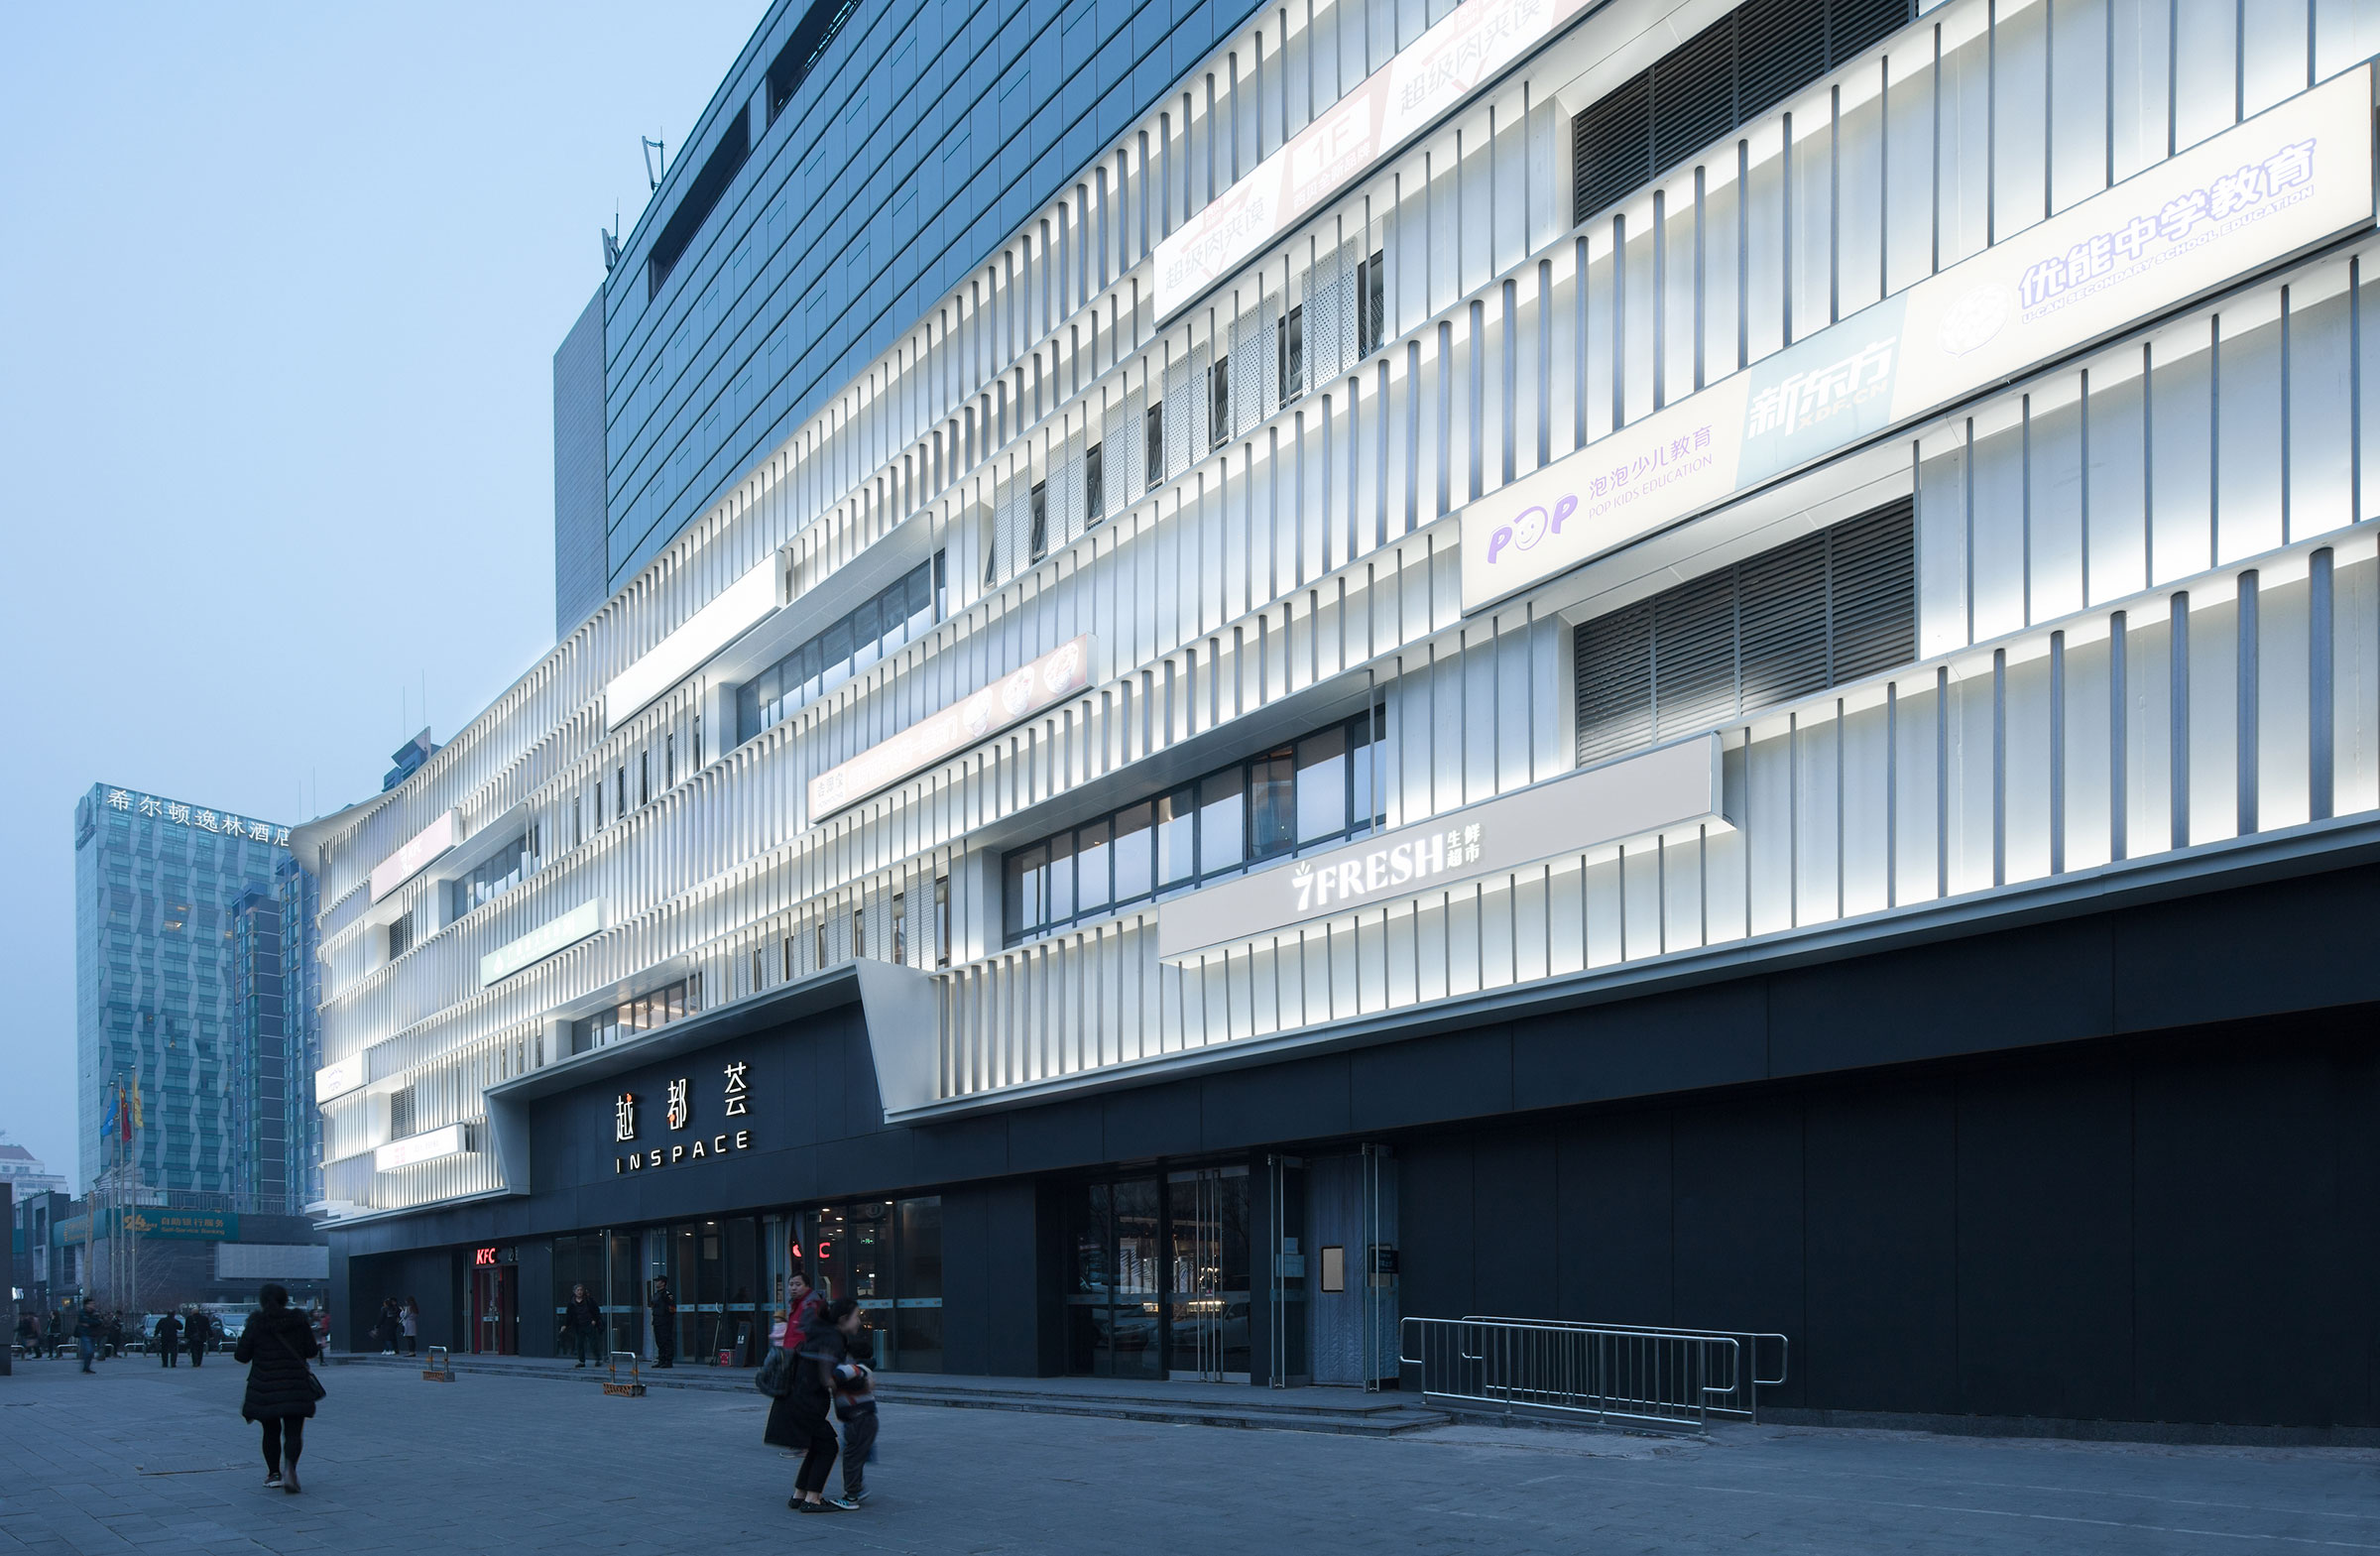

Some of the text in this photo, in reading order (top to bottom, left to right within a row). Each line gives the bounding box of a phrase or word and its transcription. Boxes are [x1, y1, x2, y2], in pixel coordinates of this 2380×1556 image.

[1312, 113, 1351, 168] 1F
[1165, 196, 1265, 294] 超级肉夹馍
[2018, 137, 2318, 309] 优能中学教育
[2021, 184, 2315, 324] U-CAN SECONDARY SCHOOL EDUCATION
[1747, 335, 1897, 439] 新东方
[1589, 423, 1714, 501] 泡泡少儿教育
[1589, 453, 1714, 520] POP KIDS EDUCATION
[1487, 492, 1579, 564] POP
[106, 787, 291, 848] 希尔顿逸林酒店
[1447, 822, 1482, 850] 生鲜
[1291, 833, 1444, 911] 7FRESH
[1446, 843, 1481, 870] 超市
[615, 1061, 747, 1142] 越都荟
[616, 1131, 748, 1174] INSPACE
[475, 1247, 496, 1265] KFC
